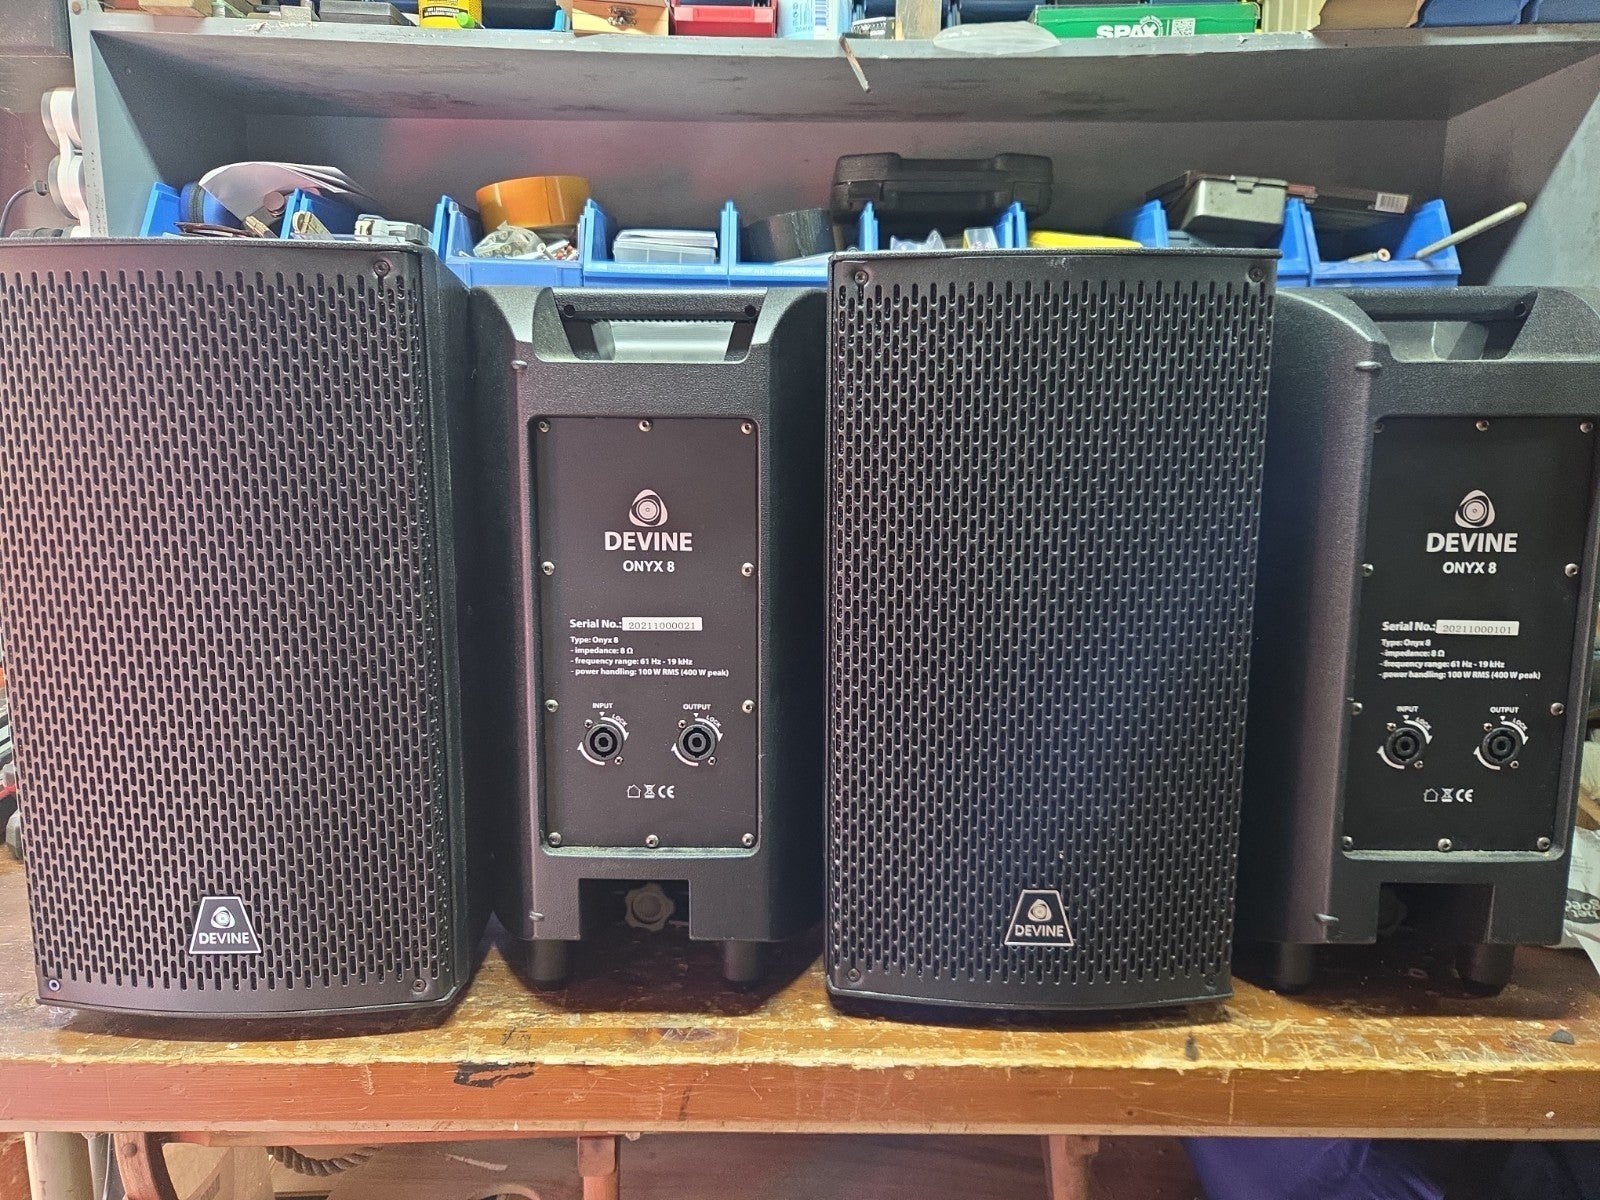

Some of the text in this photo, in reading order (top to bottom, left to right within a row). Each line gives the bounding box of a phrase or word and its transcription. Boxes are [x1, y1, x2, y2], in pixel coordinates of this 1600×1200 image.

[1096, 24, 1159, 38] SPAX
[604, 531, 693, 551] DEVINE
[1426, 532, 1518, 553] DEVINE
[622, 560, 675, 572] ONYX 8
[1442, 562, 1497, 574] ONYX 8
[569, 619, 696, 630] Serial No.: 20211000021
[1382, 621, 1512, 634] Serial No.: 20211000101
[570, 636, 591, 645] Type:
[592, 637, 612, 645] Onyx
[1381, 639, 1402, 648] Type:
[1404, 639, 1424, 648] Onyx
[575, 647, 619, 655] impedance:
[1384, 650, 1430, 658] impedance:
[575, 657, 614, 666] frequency
[678, 658, 693, 666] kHz
[1383, 660, 1423, 669] frequency
[600, 668, 637, 677] handling:
[680, 668, 697, 677] (400
[707, 669, 729, 677] peak)
[1382, 672, 1408, 680] power
[1408, 671, 1446, 680] handling:
[1491, 672, 1508, 680] (400
[1519, 672, 1541, 680] peak)
[611, 713, 628, 727] LOCK
[706, 714, 722, 727] LOCK
[1415, 717, 1432, 730] LOCK
[1512, 717, 1528, 731] LOCK
[1014, 924, 1064, 937] DEVINE
[198, 932, 250, 944] DEVINE
